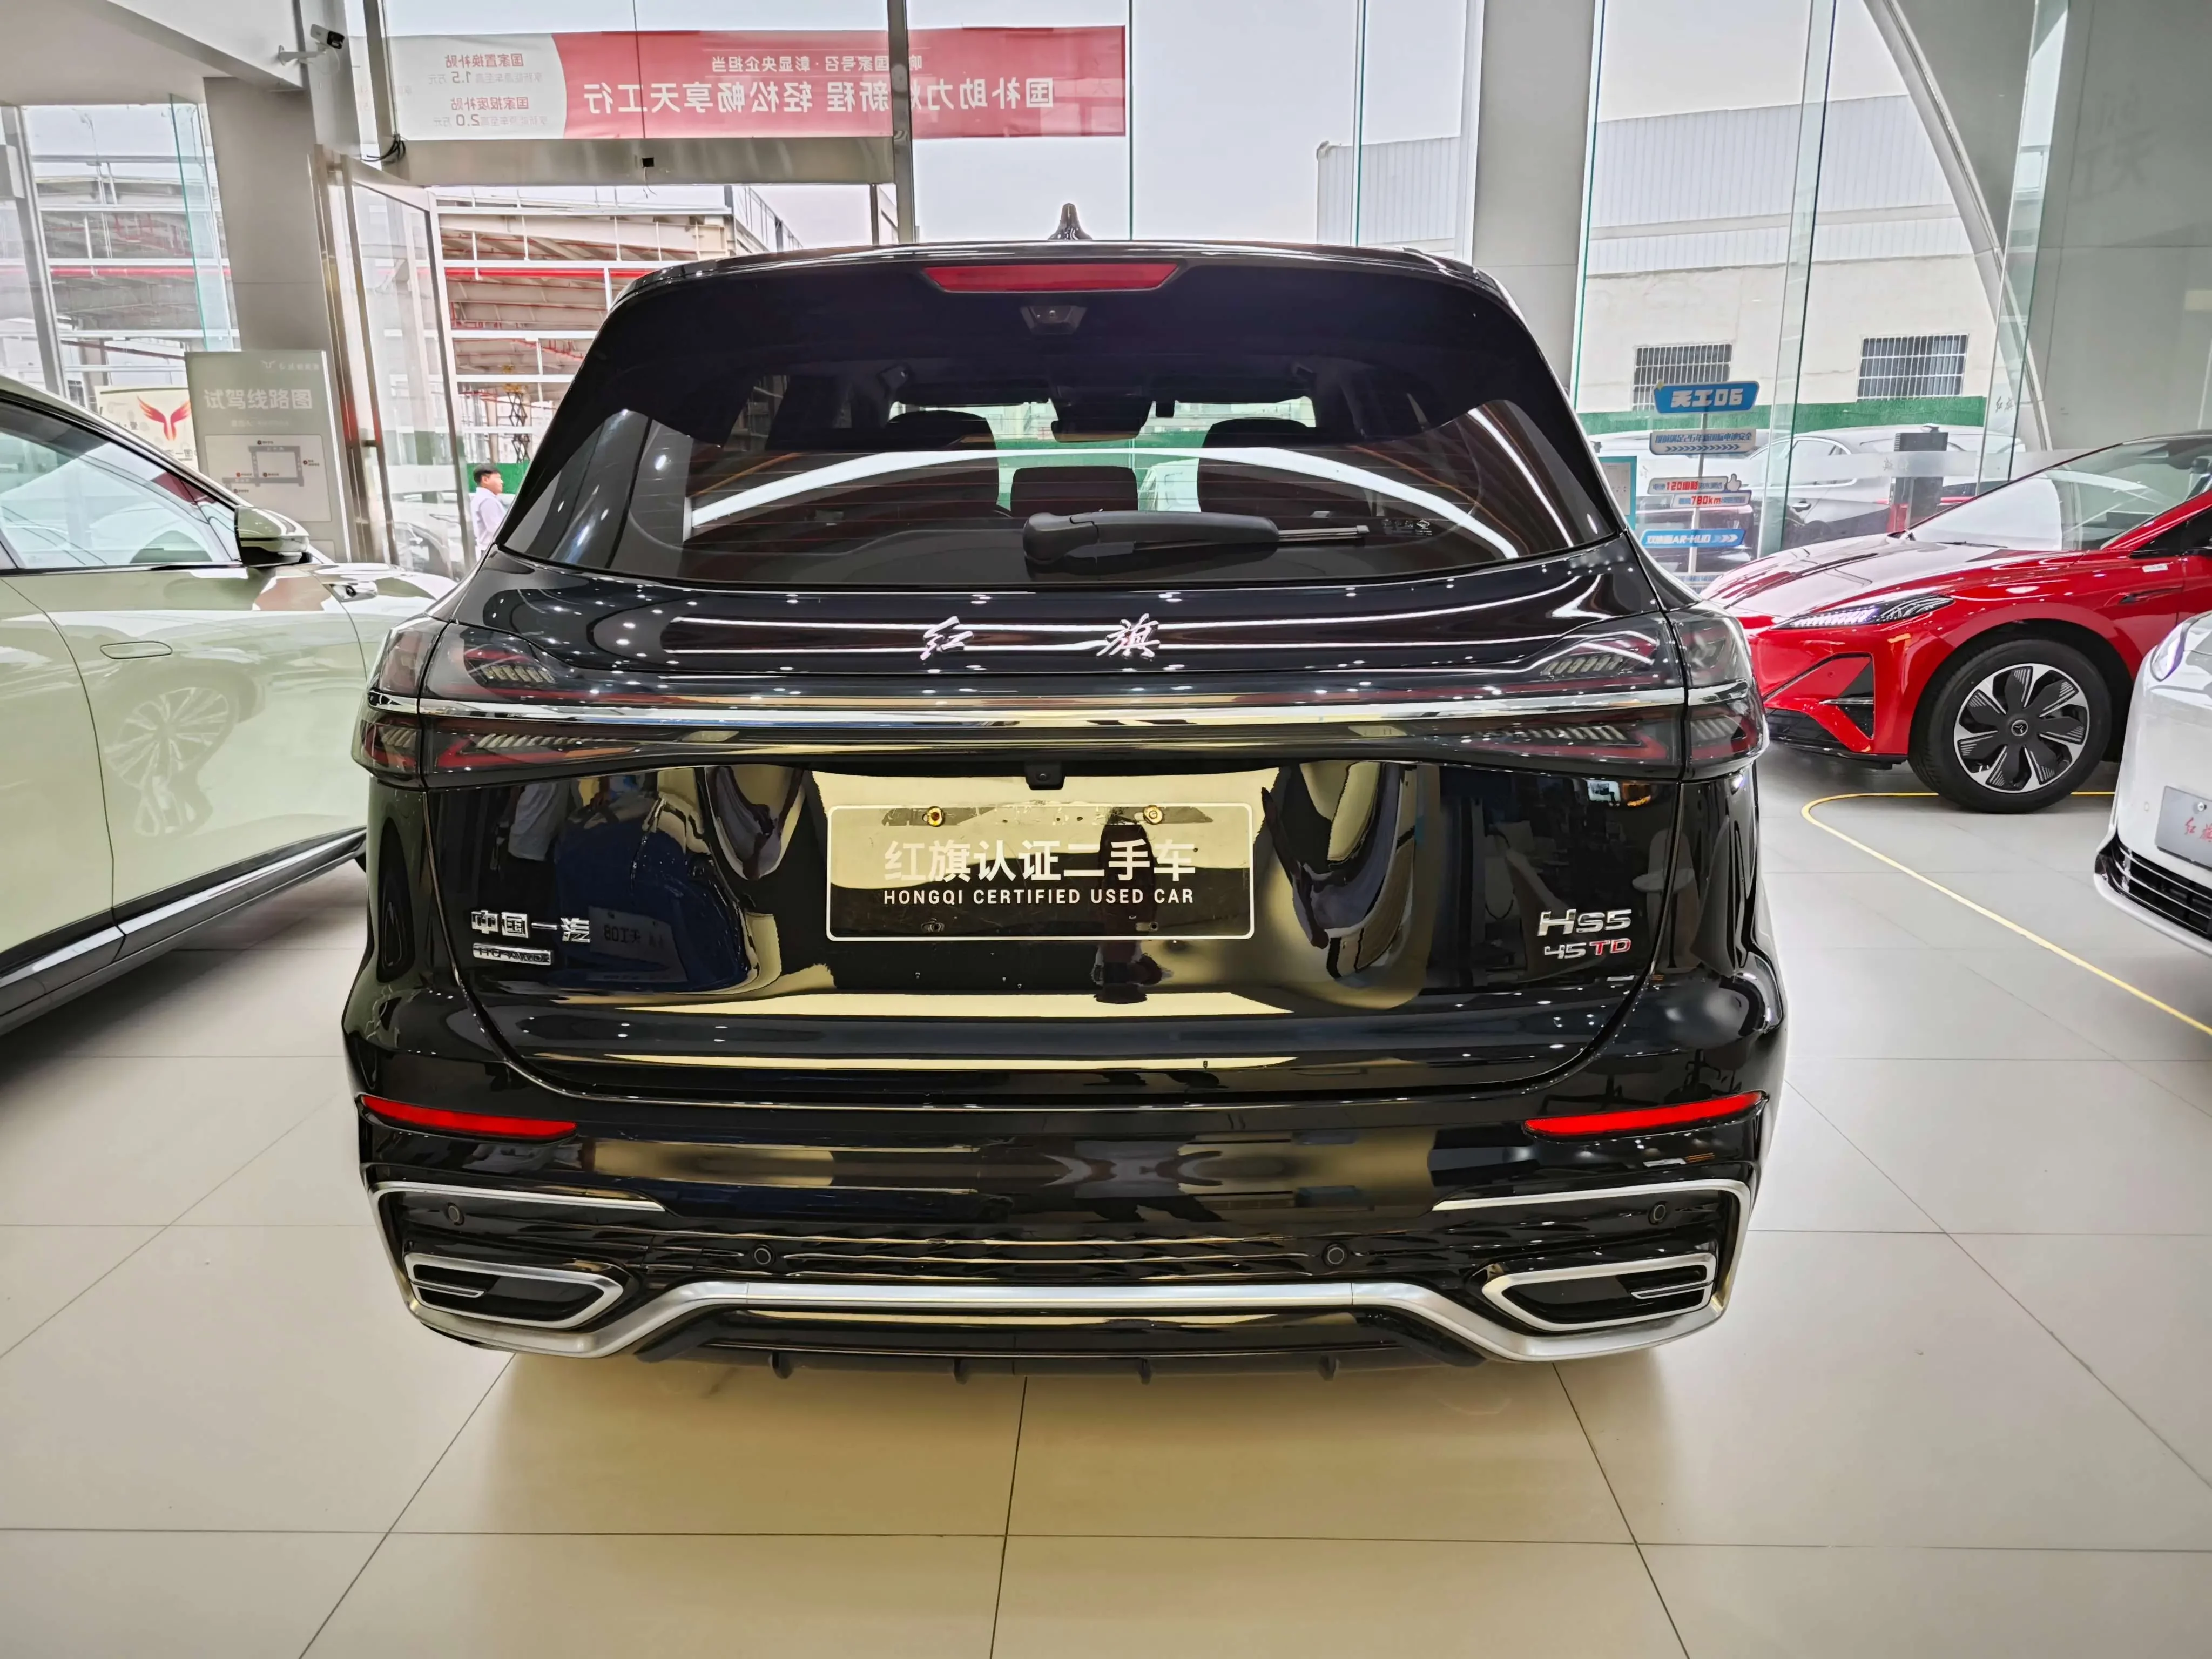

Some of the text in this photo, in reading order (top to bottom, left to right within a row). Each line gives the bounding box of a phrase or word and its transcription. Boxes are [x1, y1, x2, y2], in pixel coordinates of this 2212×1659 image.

[204, 388, 313, 410] 试驾线路图
[1671, 388, 1744, 408] 天工06
[884, 839, 1196, 883] 红旗认证二手车
[884, 889, 1194, 905] HONGQI CERTIFIED USED CAR
[1537, 908, 1632, 936] HS5
[1543, 938, 1632, 959] 45TD
